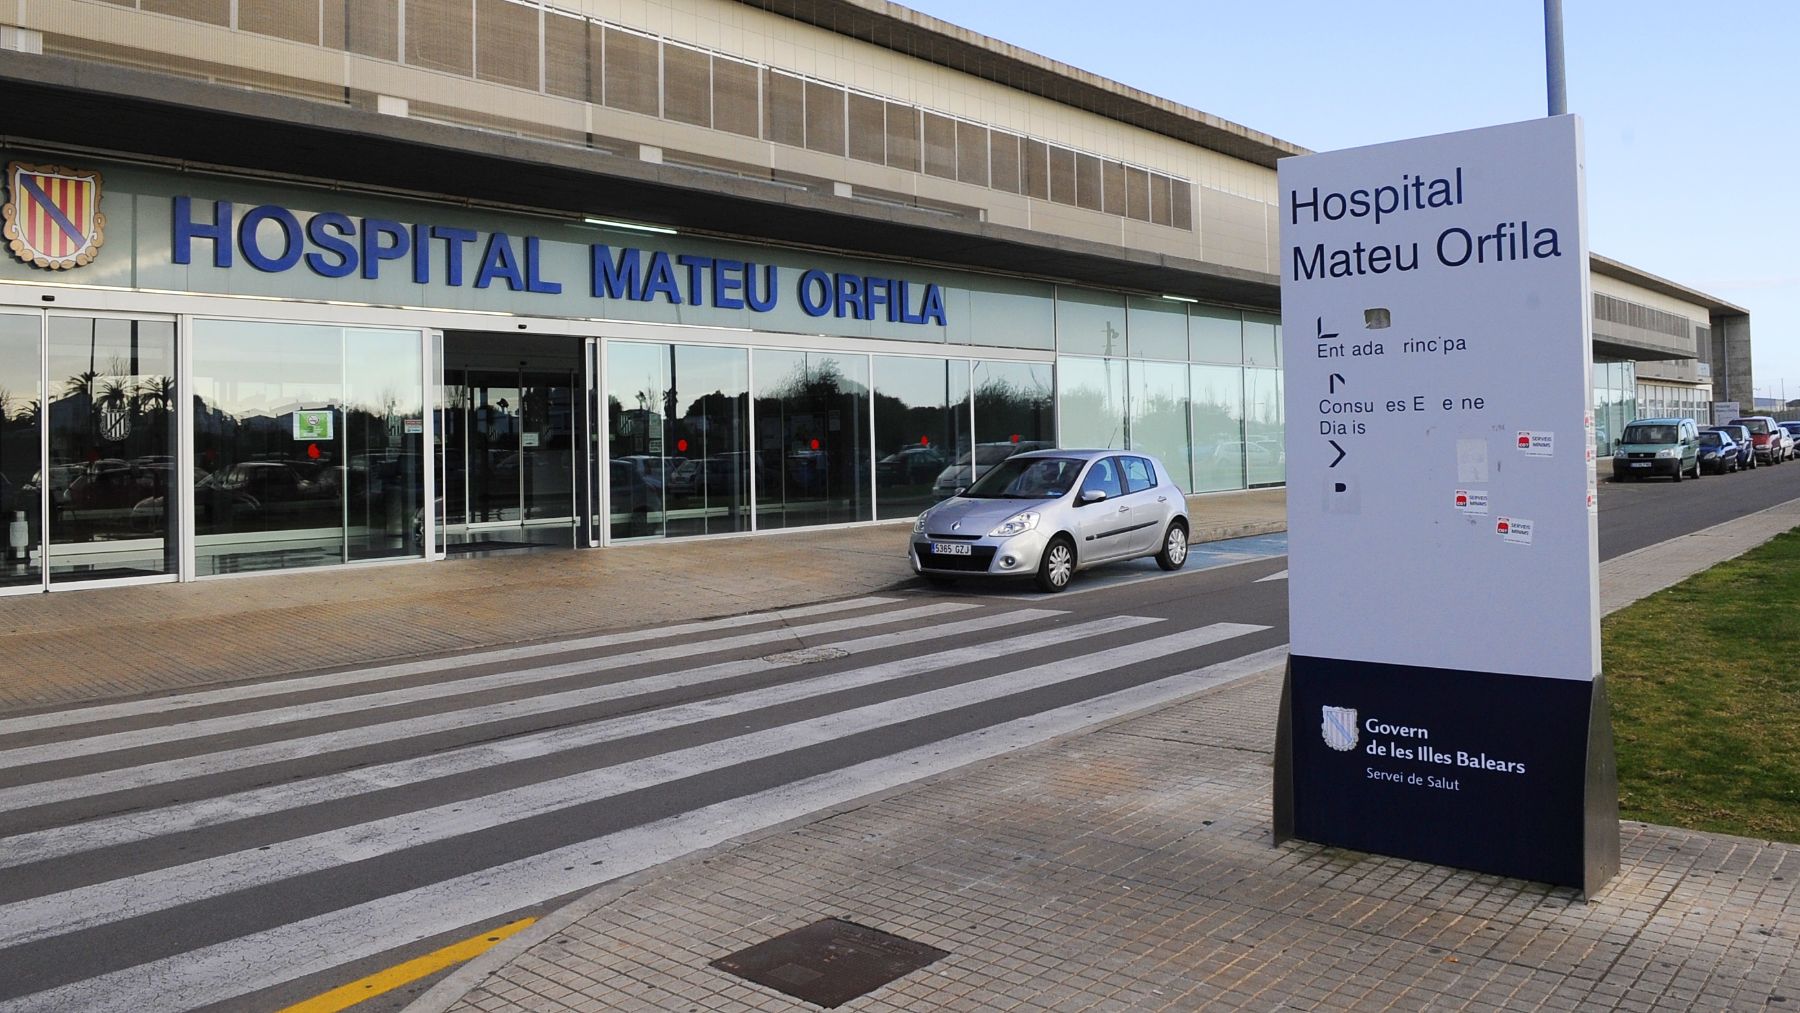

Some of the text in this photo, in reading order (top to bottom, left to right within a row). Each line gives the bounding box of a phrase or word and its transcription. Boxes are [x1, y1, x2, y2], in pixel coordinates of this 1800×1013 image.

[1291, 167, 1463, 224] Hospital
[171, 195, 947, 326] HOSPITAL MATEU ORFILA
[1293, 221, 1561, 281] Mateu Orfila
[1317, 341, 1384, 358] Entada
[935, 544, 970, 554] 5365 GZJ
[1365, 718, 1428, 740] Govern
[1366, 740, 1526, 774] de les Illes Balears
[1366, 767, 1460, 791] Servei de Salut
